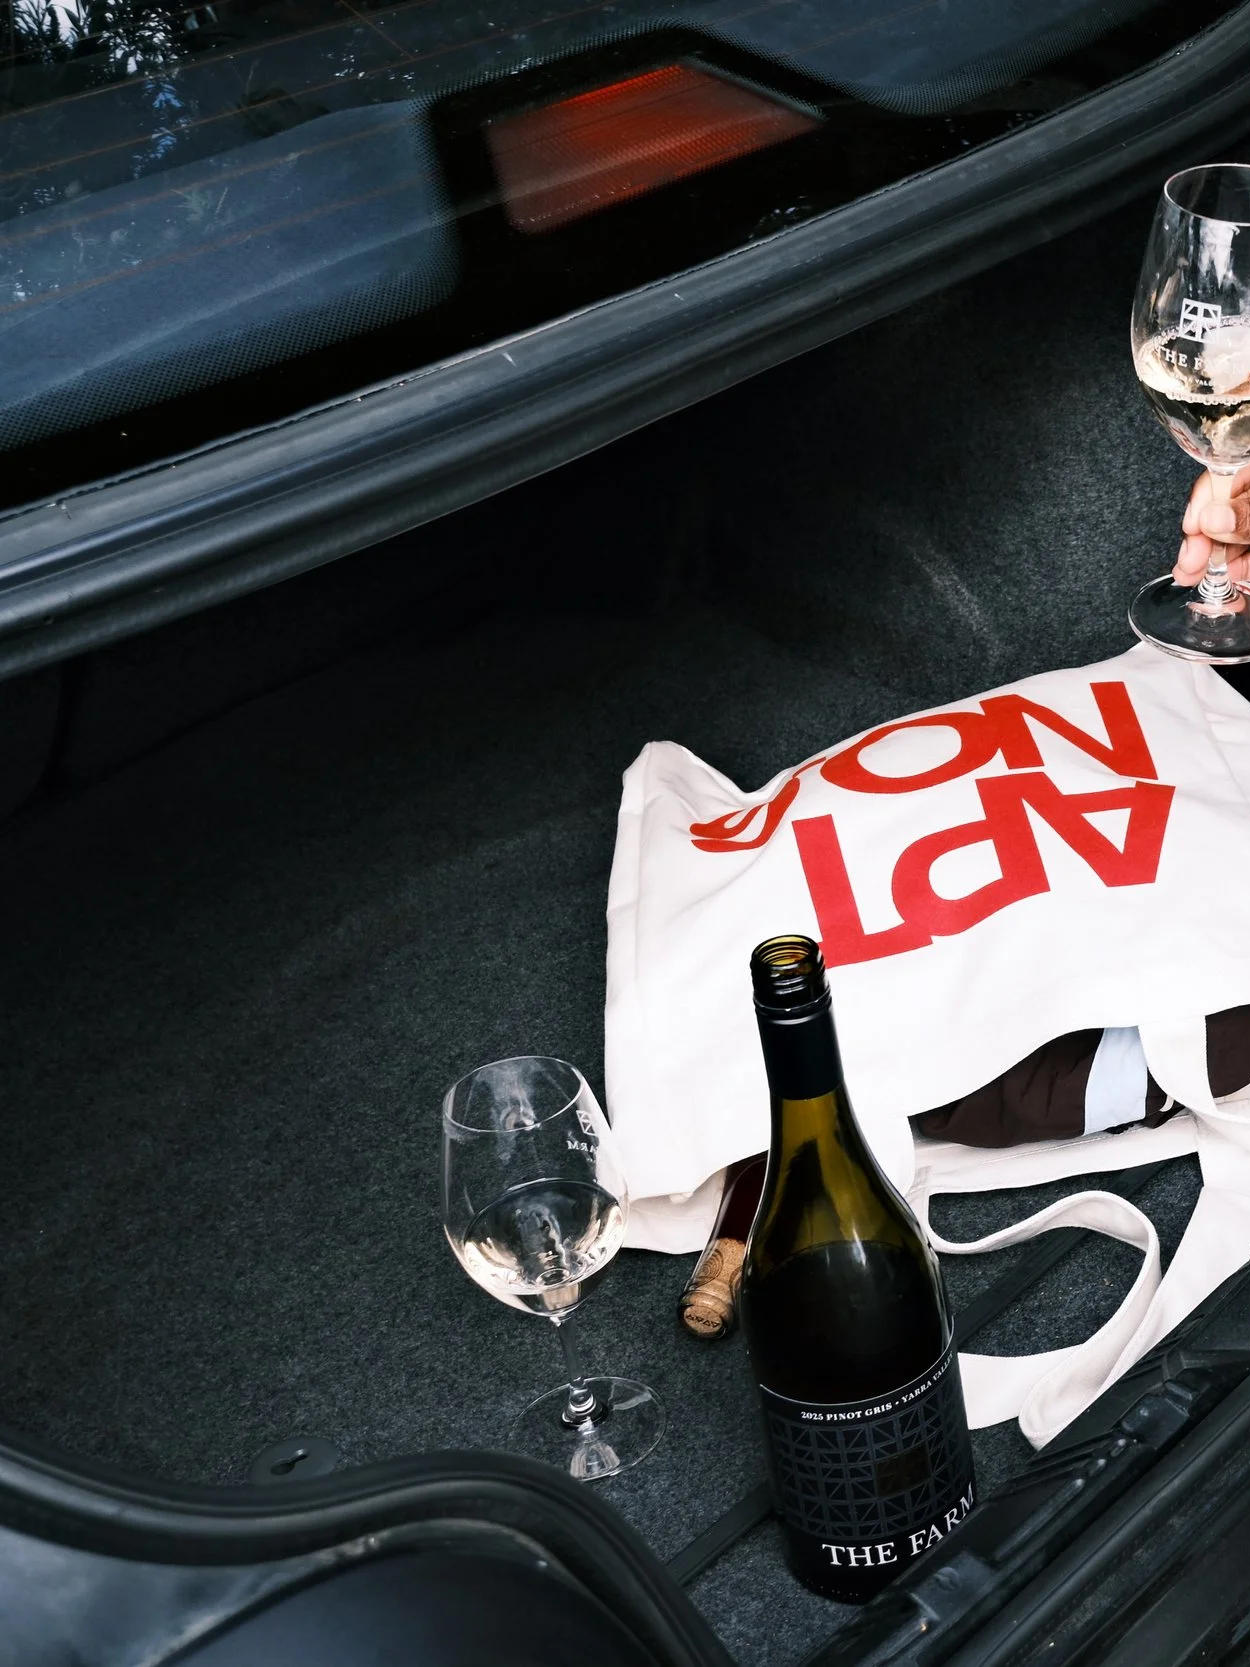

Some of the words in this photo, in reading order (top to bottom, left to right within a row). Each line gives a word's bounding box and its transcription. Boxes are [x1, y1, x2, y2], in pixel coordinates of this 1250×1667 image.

[793, 771, 1176, 969] APT
[800, 1410, 824, 1421] 2025
[826, 1410, 863, 1421] PINOT
[864, 1402, 894, 1417] GRIS
[901, 1380, 933, 1404] YARRA
[821, 1541, 898, 1567] THE
[908, 1481, 974, 1556] FARM
